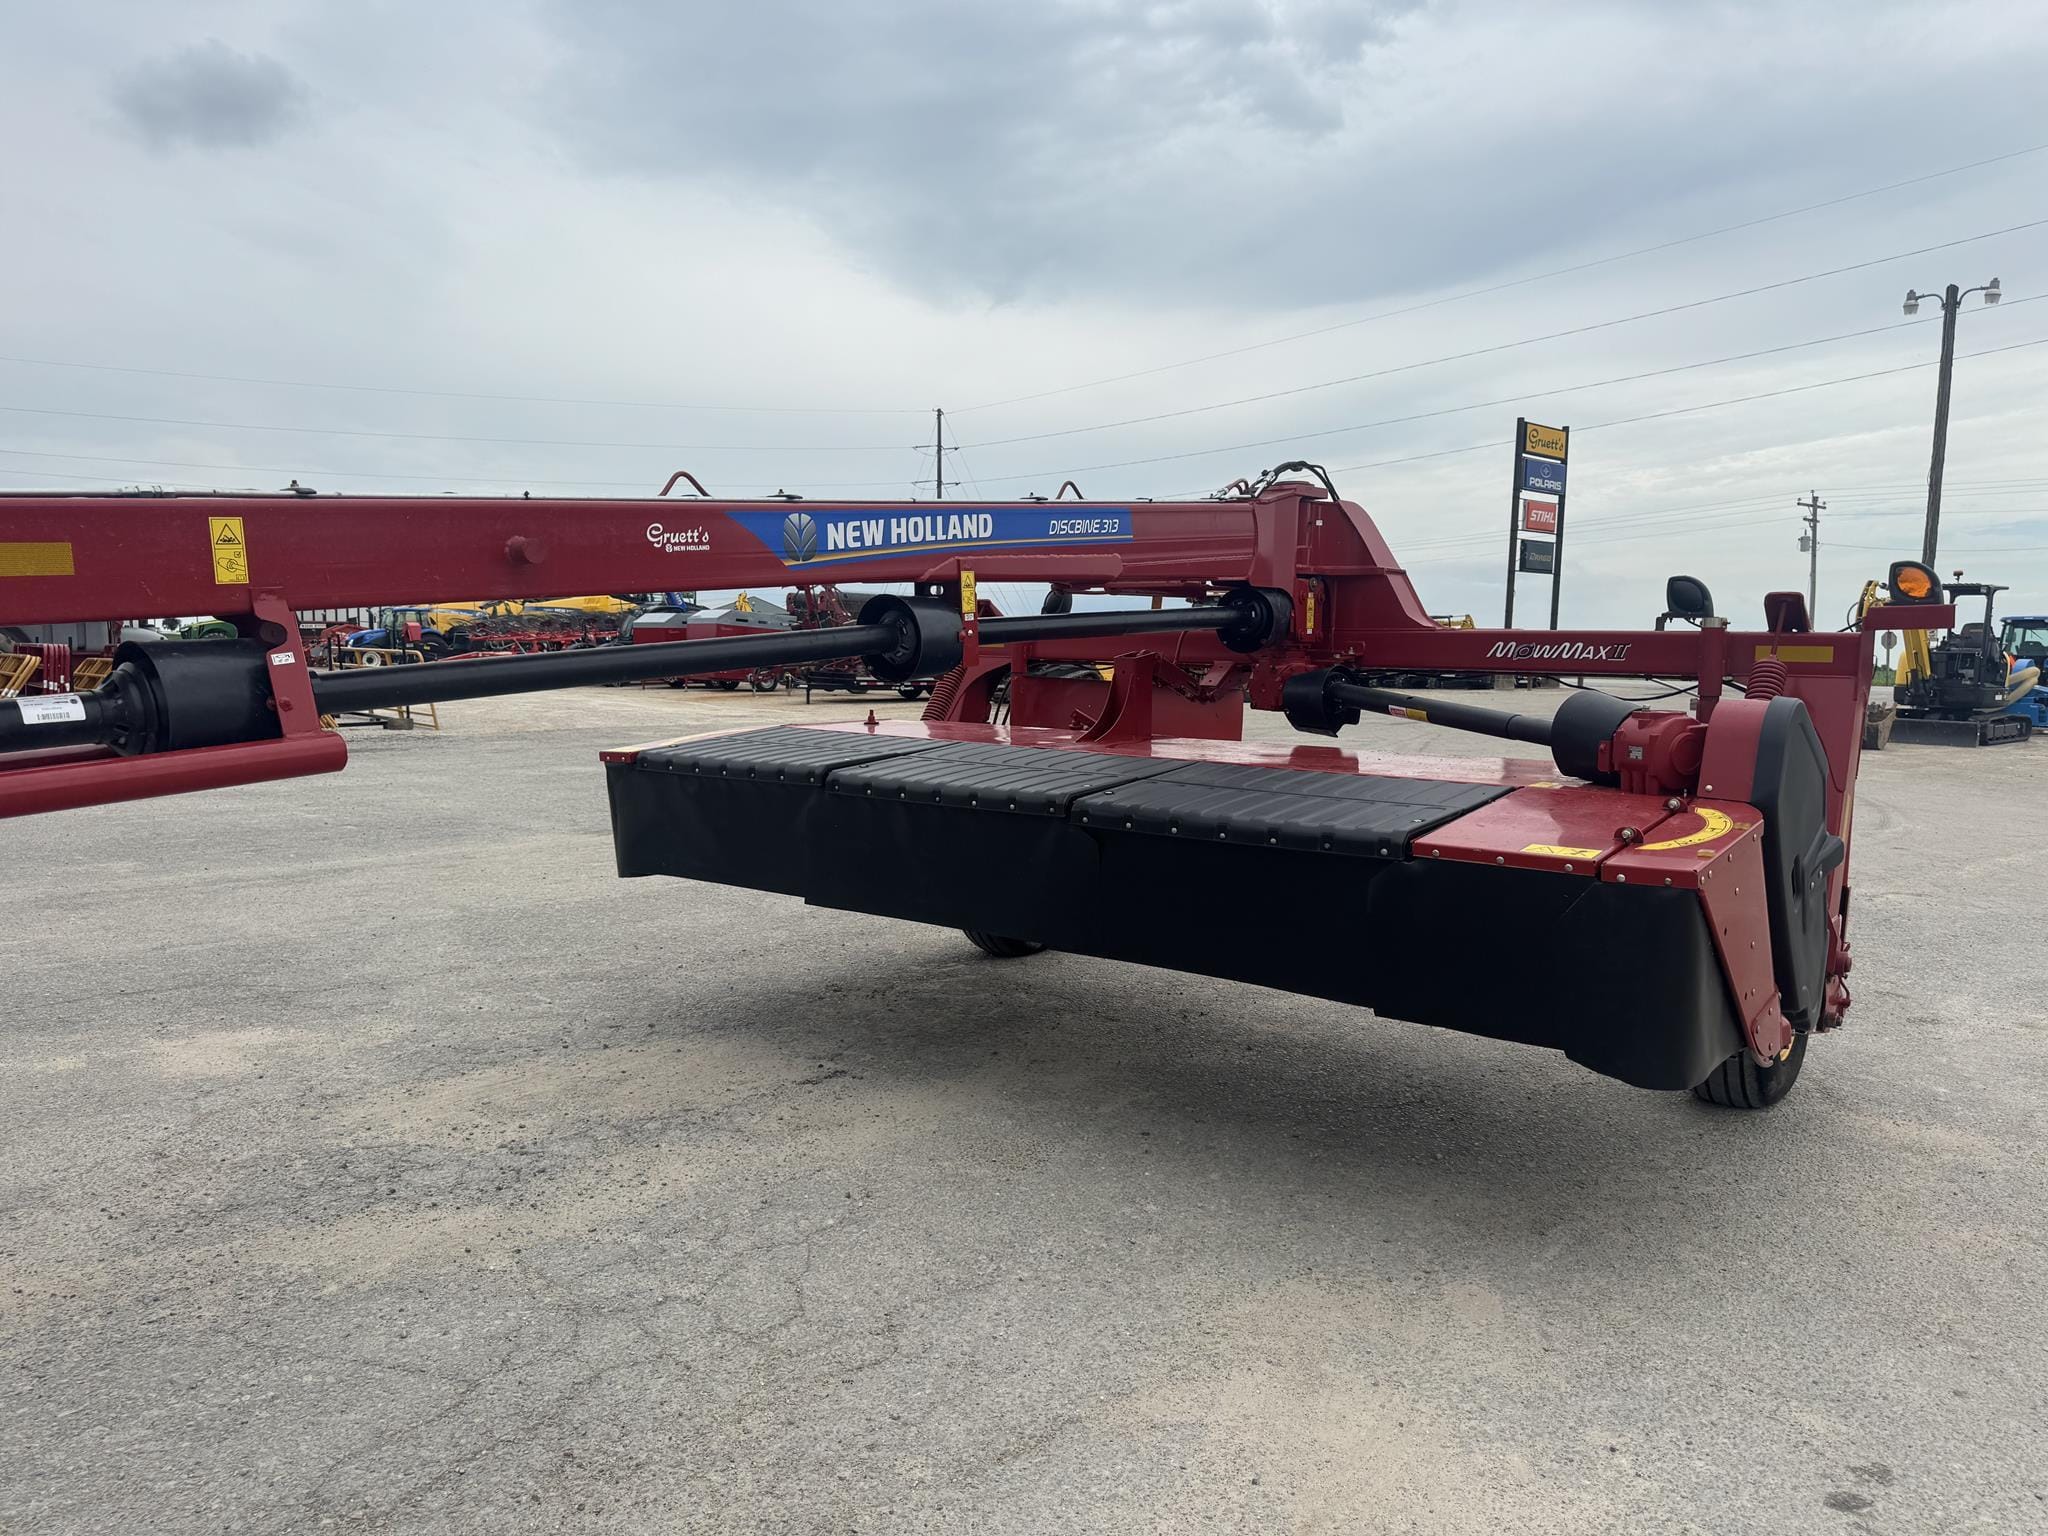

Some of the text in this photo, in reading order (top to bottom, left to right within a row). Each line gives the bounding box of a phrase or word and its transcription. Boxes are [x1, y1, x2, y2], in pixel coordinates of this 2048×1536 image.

[1528, 428, 1564, 451] Gruett's
[1529, 476, 1562, 491] POLARIS
[1530, 509, 1555, 524] STIHL
[646, 523, 709, 547] Gruett's
[826, 513, 993, 550] NEW HOLLAND
[1048, 518, 1120, 536] DISCBINE 313
